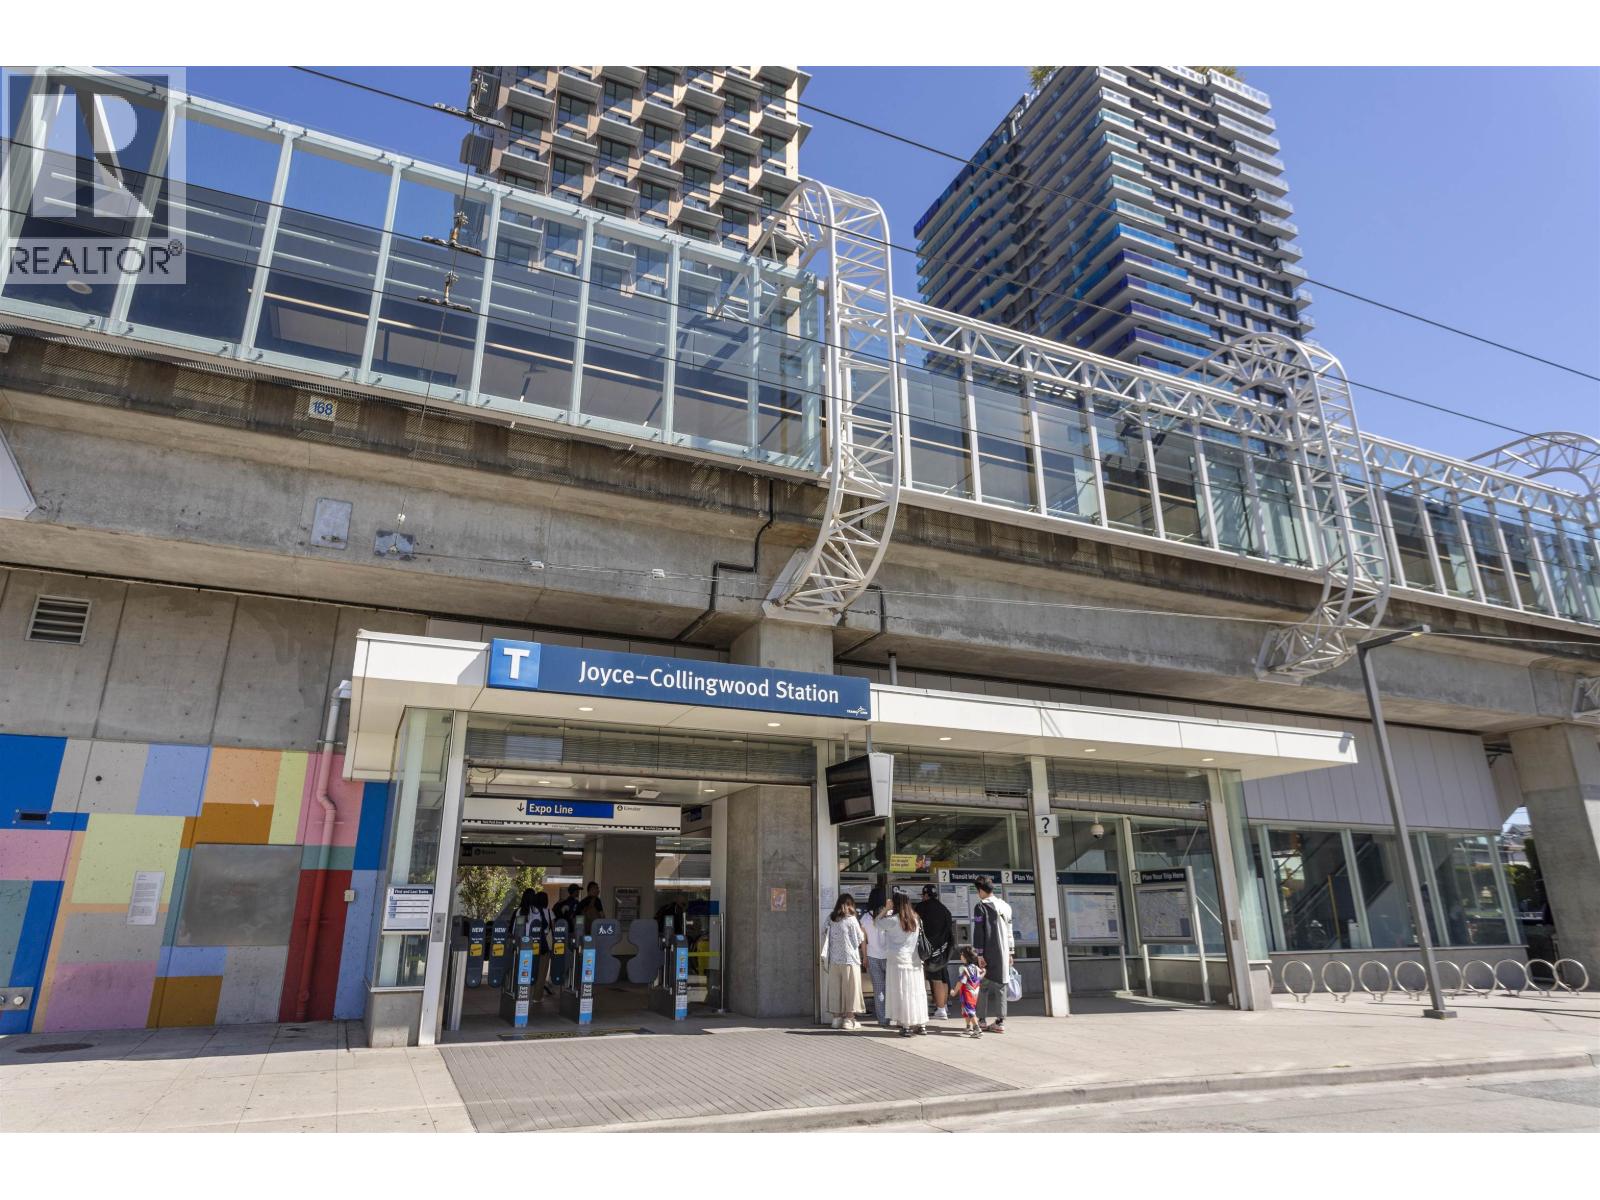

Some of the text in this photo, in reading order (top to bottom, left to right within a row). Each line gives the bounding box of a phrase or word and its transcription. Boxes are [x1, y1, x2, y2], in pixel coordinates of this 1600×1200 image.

[313, 401, 333, 416] 168
[775, 680, 840, 704] Station
[529, 803, 574, 816] Expo Line
